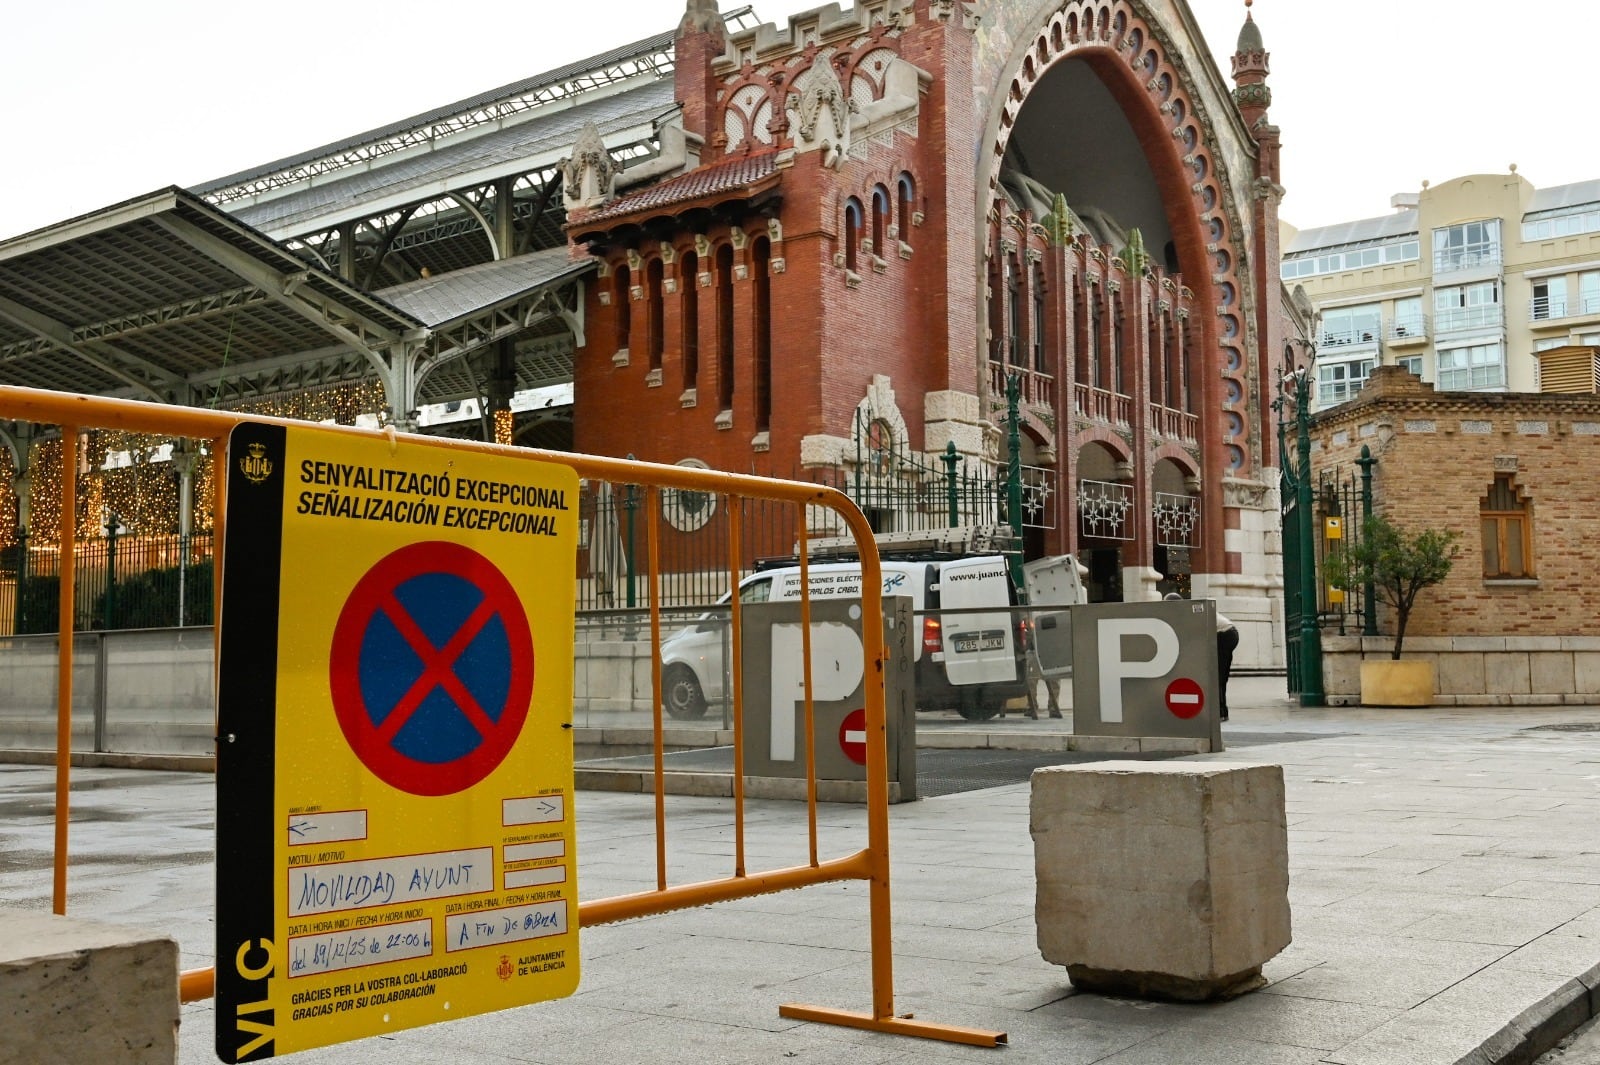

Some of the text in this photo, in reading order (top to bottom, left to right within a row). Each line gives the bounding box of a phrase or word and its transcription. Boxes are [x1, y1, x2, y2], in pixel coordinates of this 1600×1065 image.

[300, 460, 569, 510] SENYALITZACIÓ EXCEPCIONAL
[297, 489, 558, 536] SEÑALIZACIÓN EXCEPCIONAL
[785, 576, 834, 586] INSTACIONES
[808, 587, 835, 595] ARLOS
[960, 640, 977, 650] 285
[1098, 618, 1179, 723] P
[770, 621, 865, 761] P
[288, 853, 312, 865] MOTIU
[318, 851, 346, 862] MOTIVO
[298, 871, 395, 910] MOVILIDAD
[446, 901, 462, 913] DATA
[466, 899, 483, 910] HORA
[484, 898, 500, 907] FINAL
[506, 895, 525, 905] FECHA
[530, 892, 546, 901] HORA
[546, 889, 562, 898] FINAL
[288, 925, 308, 936] DATA
[313, 922, 334, 932] HORA
[334, 919, 350, 929] INICI
[355, 915, 378, 926] FECHA
[379, 914, 385, 922] Y
[384, 911, 403, 921] HORA
[404, 908, 424, 919] INICIO
[459, 922, 469, 946] A
[518, 950, 566, 965] AJUNTAMENT
[518, 961, 566, 977] DE VALÈNCIA
[236, 937, 275, 1060] VLC
[291, 986, 331, 1005] GRÀCIES
[334, 984, 351, 998] PER
[354, 982, 366, 994] LA
[367, 976, 401, 991] VOSTRA
[292, 984, 436, 1021] GRACIAS POR SU COLABORACIÓN
